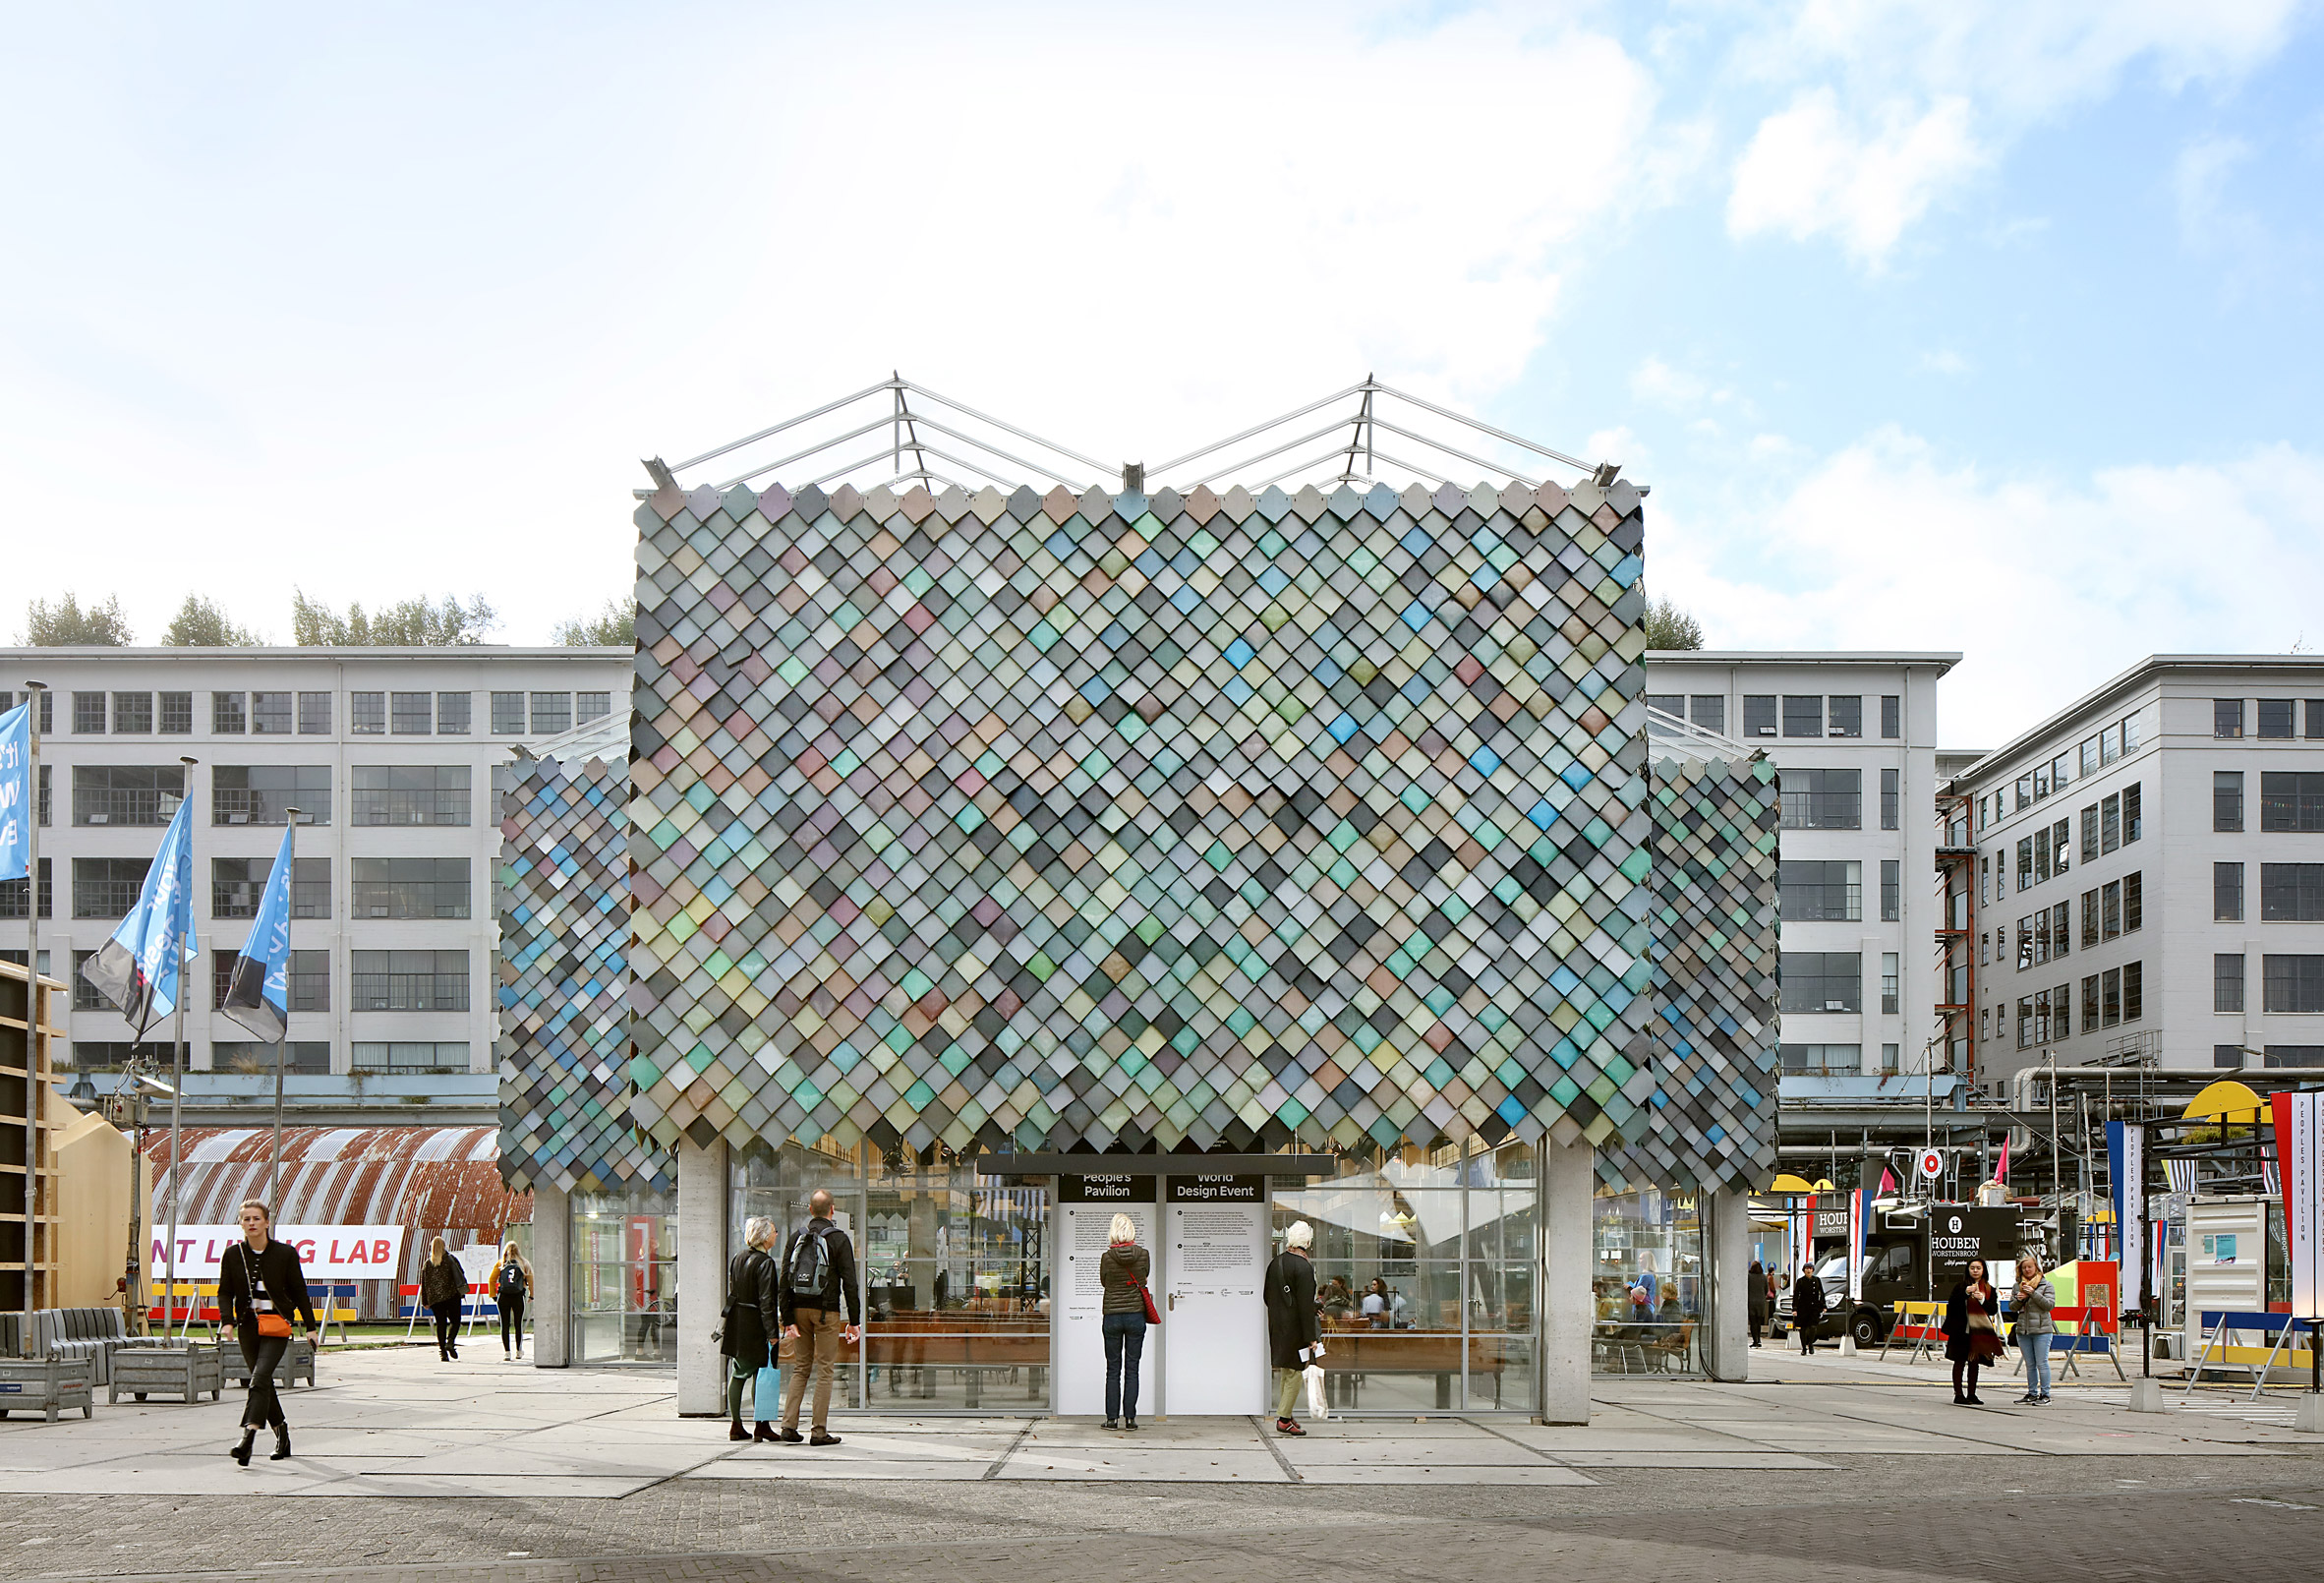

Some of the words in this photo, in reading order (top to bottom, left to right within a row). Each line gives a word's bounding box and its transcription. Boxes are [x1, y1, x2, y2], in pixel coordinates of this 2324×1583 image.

[1083, 1174, 1132, 1185] People's
[1084, 1185, 1131, 1197] Pavilion
[1177, 1186, 1217, 1200] Design
[1220, 1186, 1254, 1197] Event
[1932, 1237, 1981, 1250] HOUBEN
[328, 1239, 391, 1264] LAB
